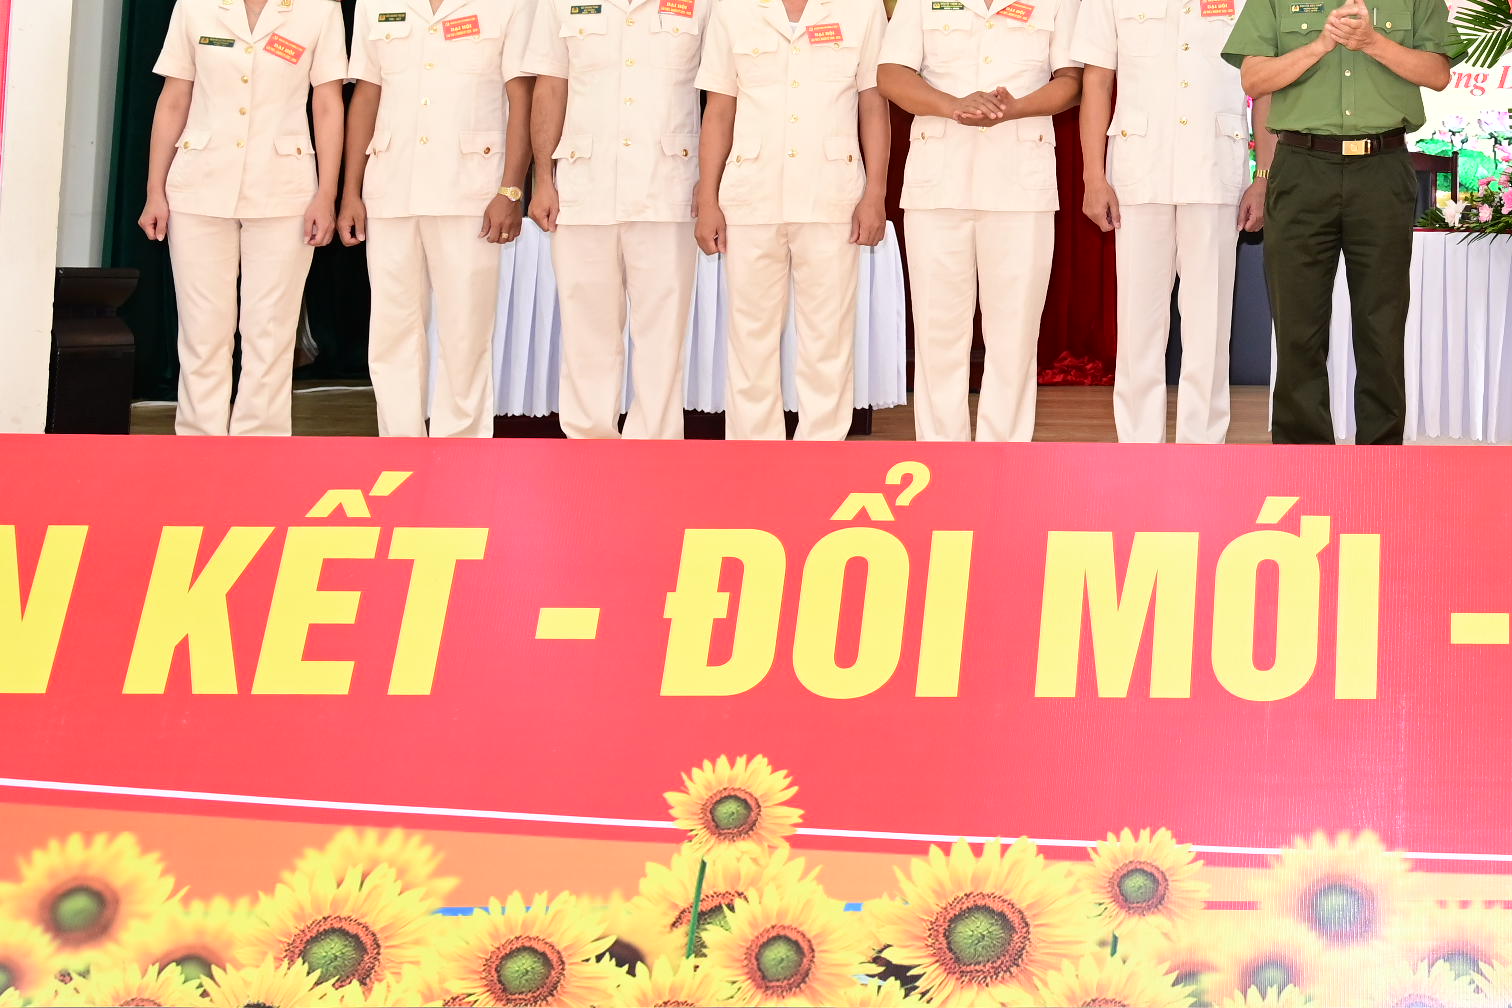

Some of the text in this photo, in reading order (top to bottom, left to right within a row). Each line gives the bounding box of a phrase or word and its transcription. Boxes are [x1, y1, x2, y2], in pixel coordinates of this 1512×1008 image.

[122, 471, 489, 695] KẾT
[660, 461, 974, 700] ĐỔI
[1034, 496, 1381, 702] MỚI
